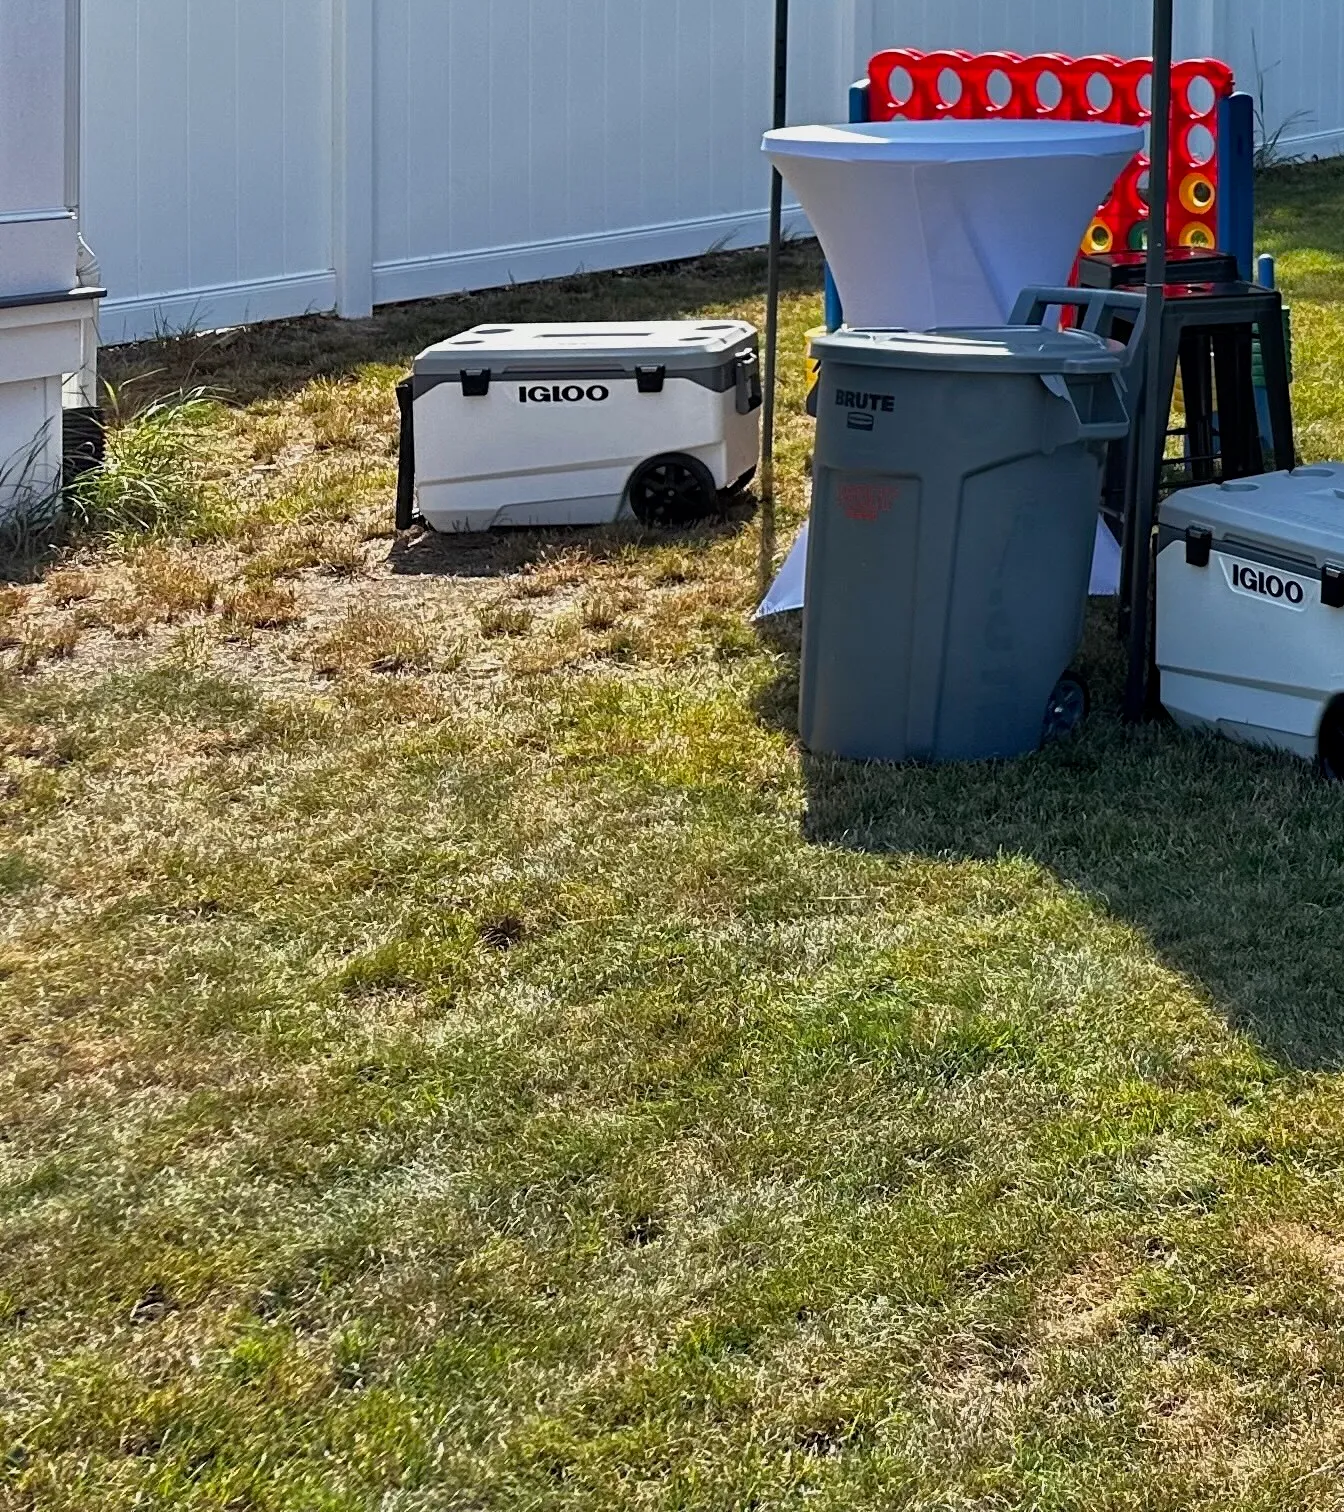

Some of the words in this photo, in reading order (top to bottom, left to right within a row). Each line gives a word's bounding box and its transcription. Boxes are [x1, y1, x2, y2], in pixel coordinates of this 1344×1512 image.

[518, 384, 609, 403] IGLOO
[835, 388, 896, 413] BRUTE
[1232, 563, 1304, 604] IGLOO
